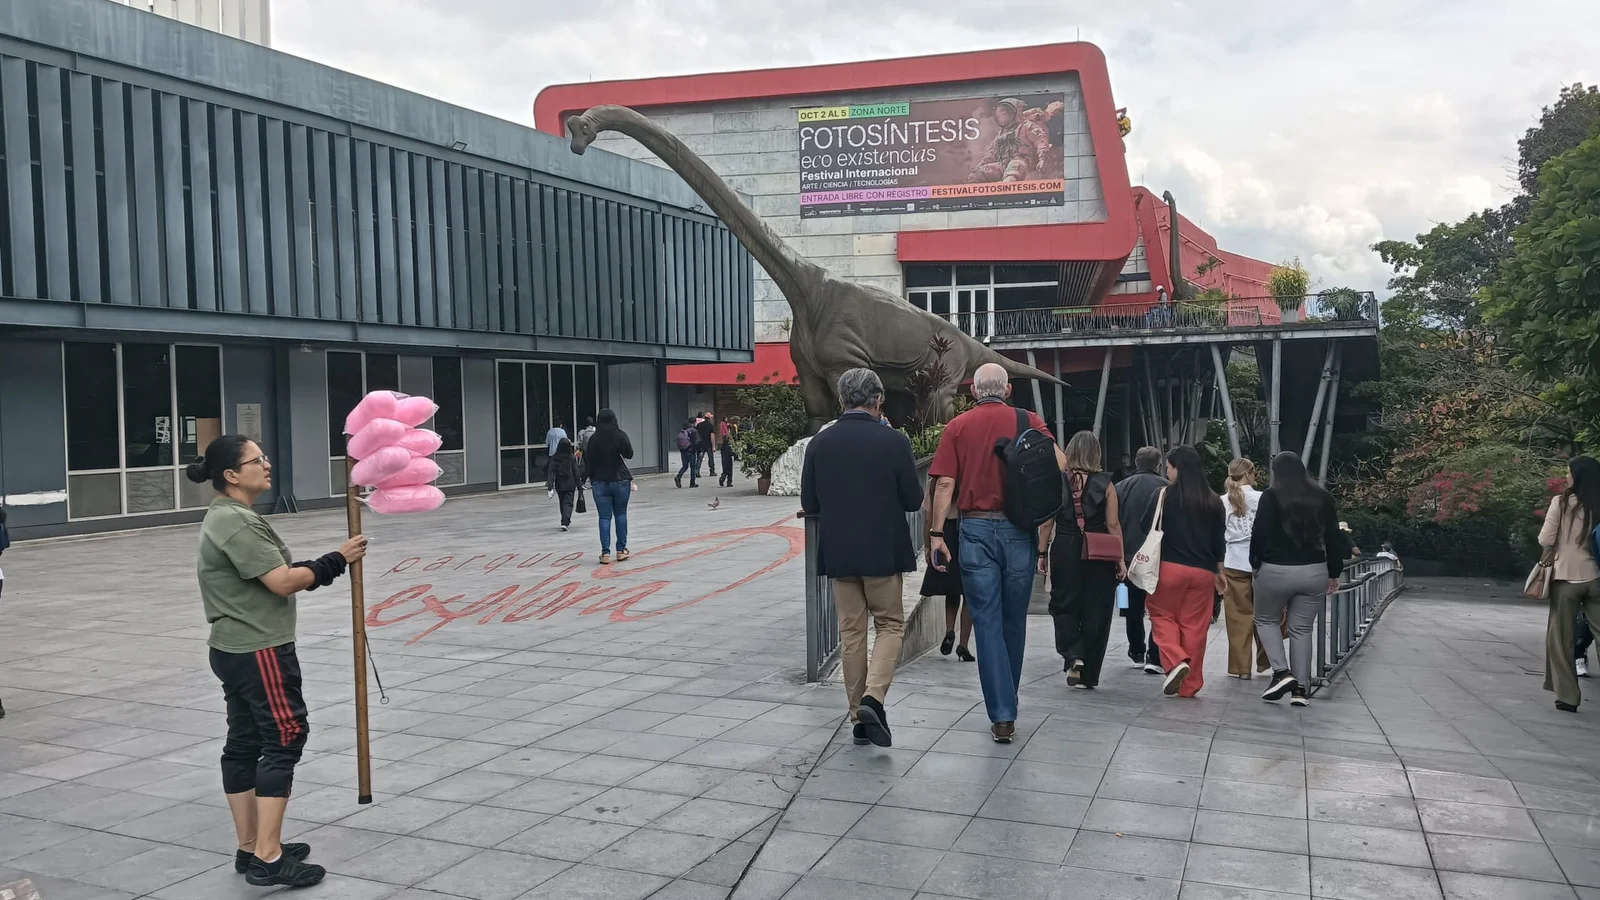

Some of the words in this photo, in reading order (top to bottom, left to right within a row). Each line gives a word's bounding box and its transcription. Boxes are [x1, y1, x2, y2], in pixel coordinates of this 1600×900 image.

[800, 111, 819, 120] OCT
[820, 110, 826, 118] 2
[828, 109, 839, 118] AL
[841, 109, 847, 117] 5
[851, 107, 875, 116] ZONA
[877, 105, 907, 114] NORTE
[800, 118, 980, 150] FOTOSÍNTESIS
[801, 154, 832, 169] eco
[837, 146, 937, 166] existencias
[801, 169, 843, 181] Festival
[846, 166, 918, 178] Internacional
[853, 178, 898, 187] TECNOLOGÍAS
[801, 193, 840, 203] ENTRADA
[842, 192, 864, 200] LIBRE
[866, 190, 885, 199] CON
[887, 189, 928, 198] REGISTRO
[931, 182, 1061, 196] FESTIVALFOTOSINTESIS.COM
[380, 551, 584, 578] parque
